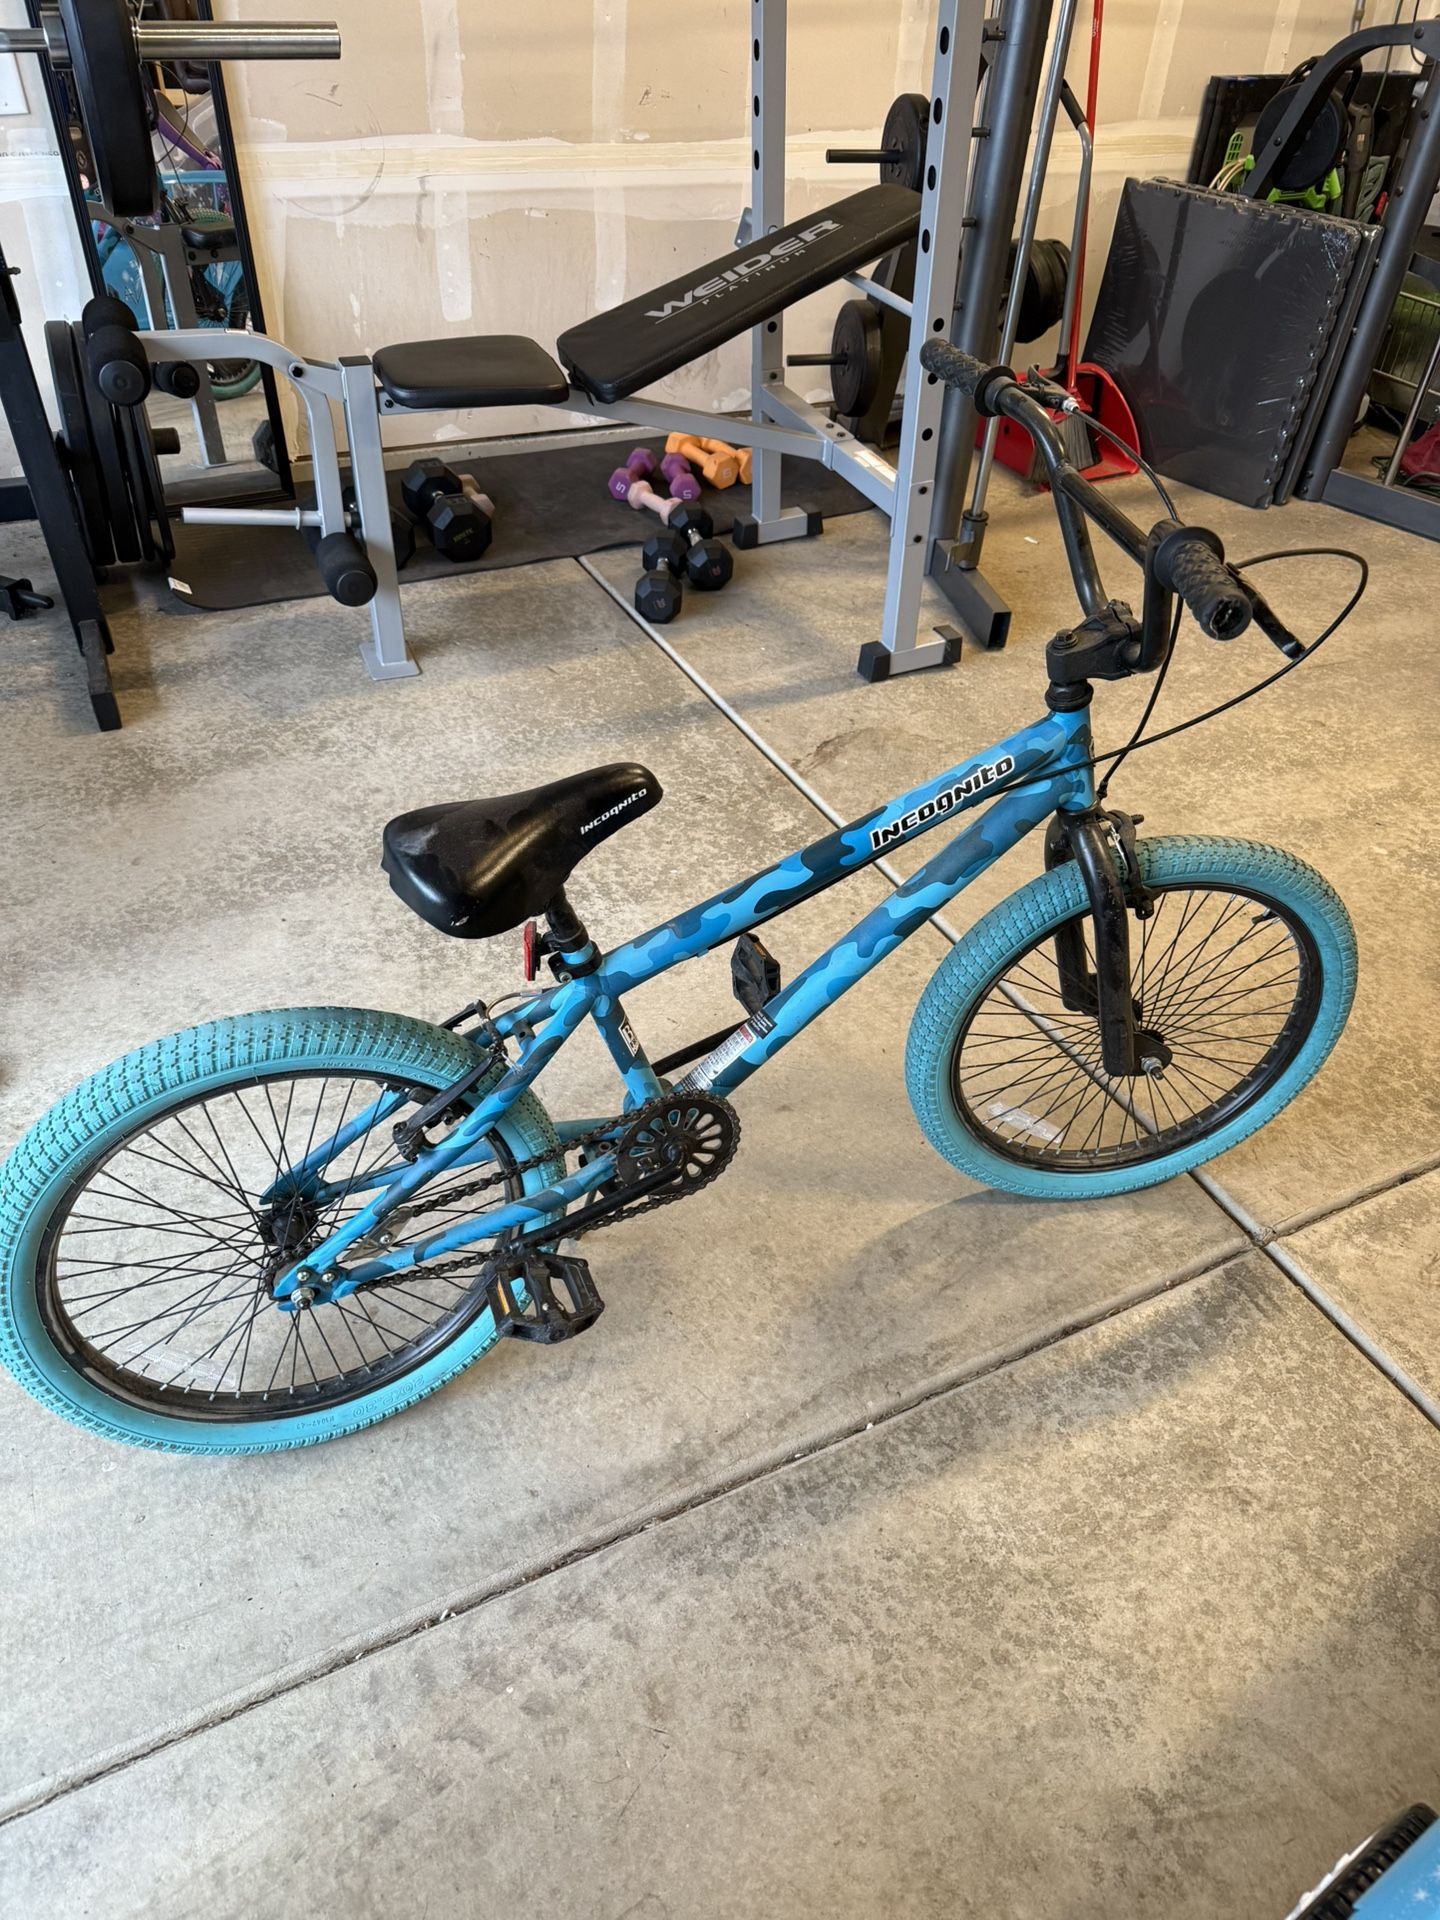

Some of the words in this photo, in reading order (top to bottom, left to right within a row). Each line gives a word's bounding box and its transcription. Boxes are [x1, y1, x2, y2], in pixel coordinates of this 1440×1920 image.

[644, 219, 842, 318] WEIDER
[702, 249, 806, 305] PLATINUM
[615, 481, 627, 493] 5
[682, 489, 692, 499] 5
